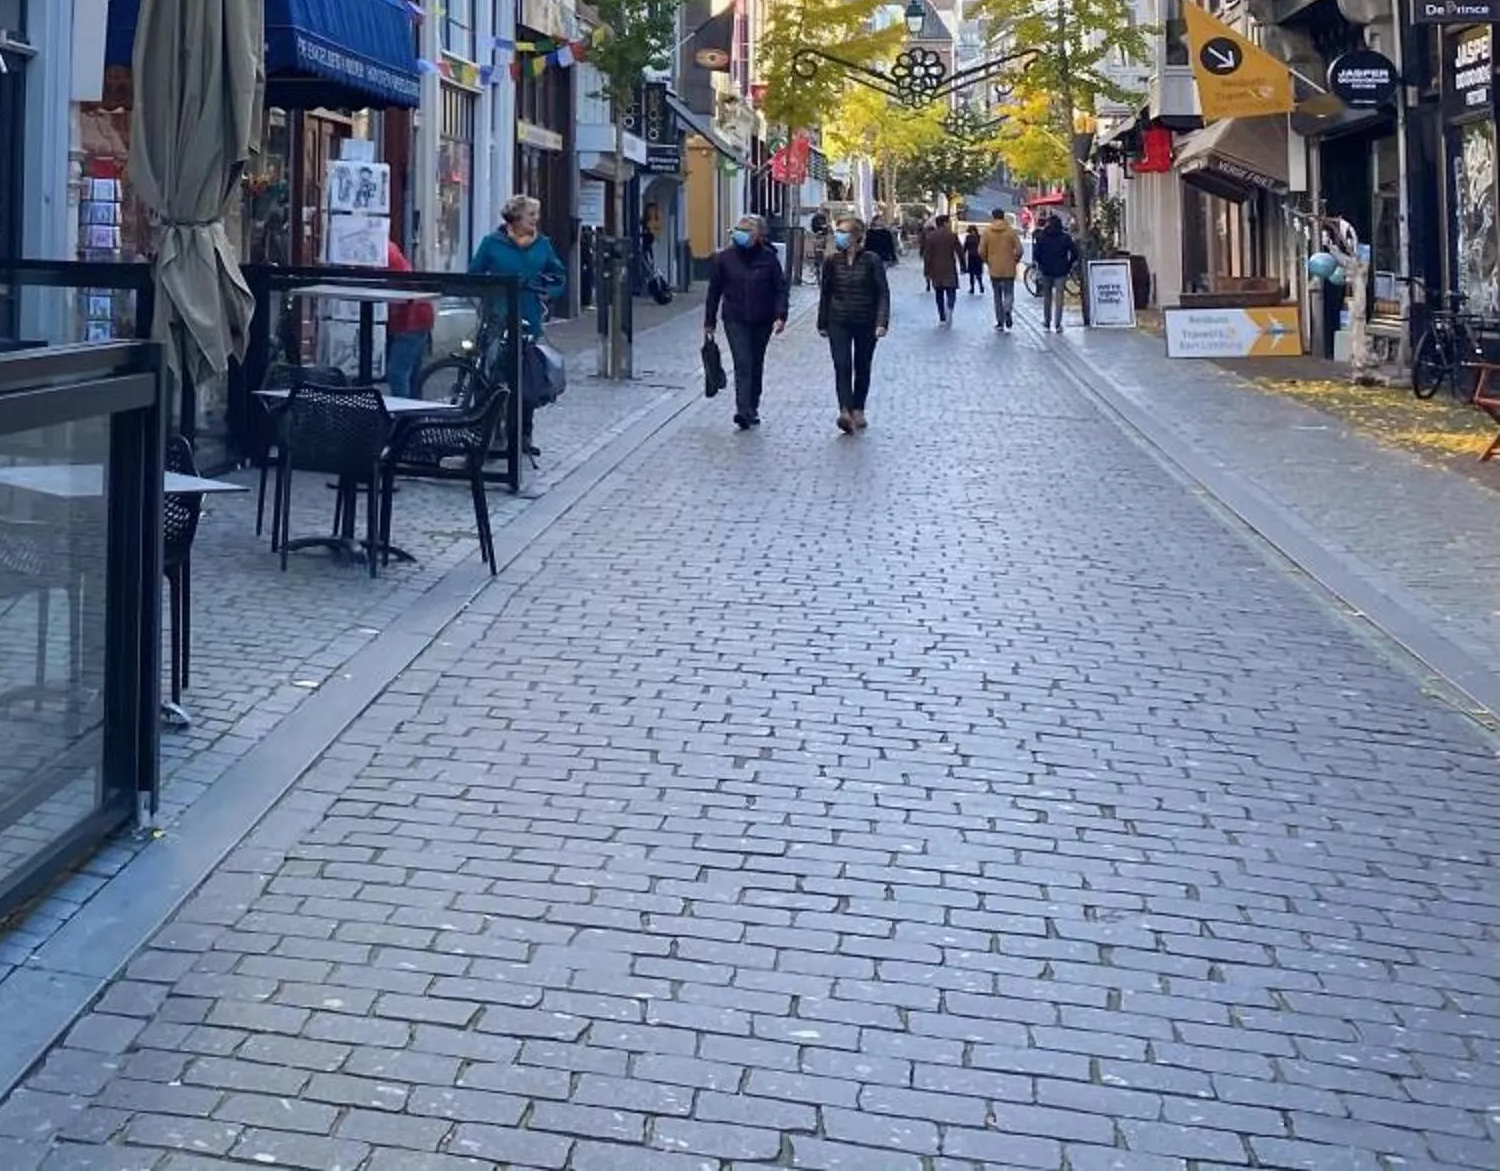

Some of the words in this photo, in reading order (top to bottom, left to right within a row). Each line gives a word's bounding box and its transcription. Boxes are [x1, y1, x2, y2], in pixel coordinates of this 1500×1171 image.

[1425, 4, 1445, 16] De
[1445, 0, 1490, 14] Prince
[1455, 37, 1491, 69] JASPE
